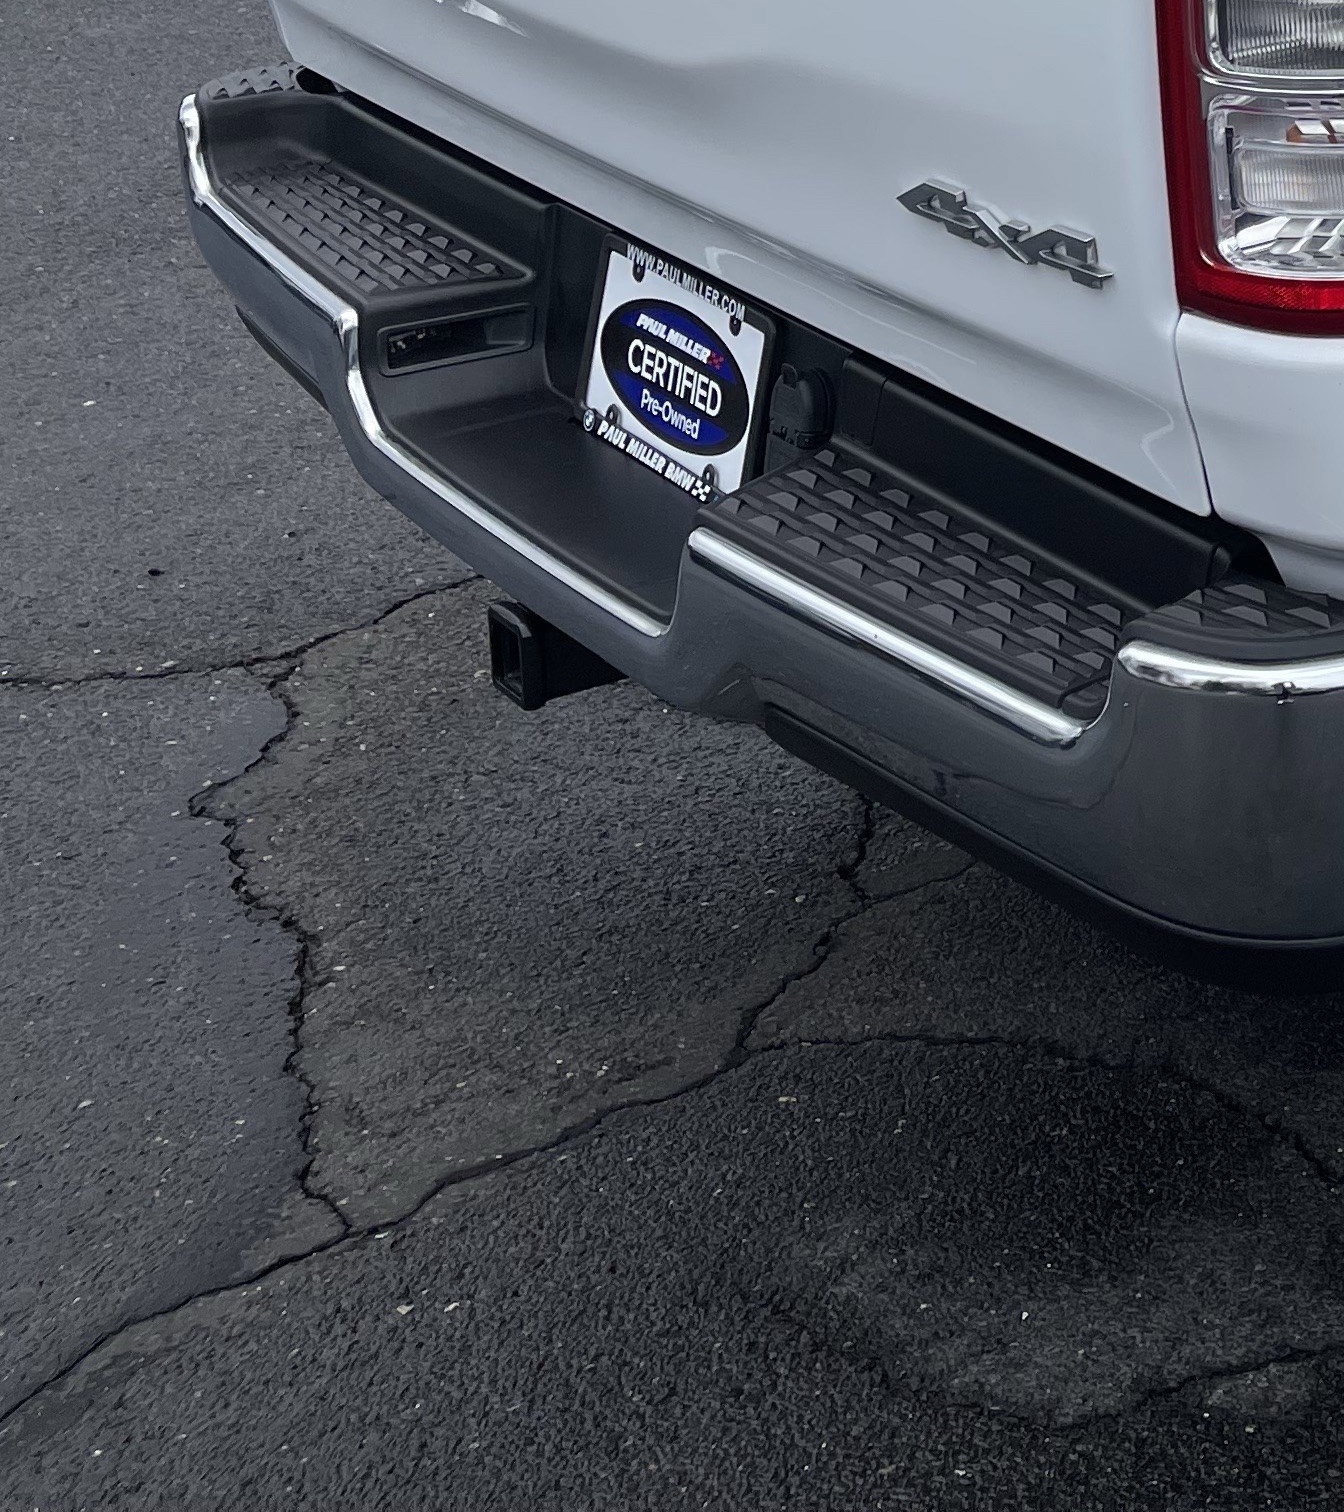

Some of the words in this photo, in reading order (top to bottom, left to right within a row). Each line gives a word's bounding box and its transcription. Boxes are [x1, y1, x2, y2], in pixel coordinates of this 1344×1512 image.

[626, 243, 746, 322] WWW.PAULMILLER.COM
[636, 313, 668, 340] PAUL
[665, 327, 711, 365] MILLER
[627, 338, 722, 418] CERTIFIED
[640, 388, 701, 440] Pre-Owned
[597, 420, 626, 451] PAUL
[626, 436, 665, 473] MILLER
[664, 464, 695, 493] BMW
